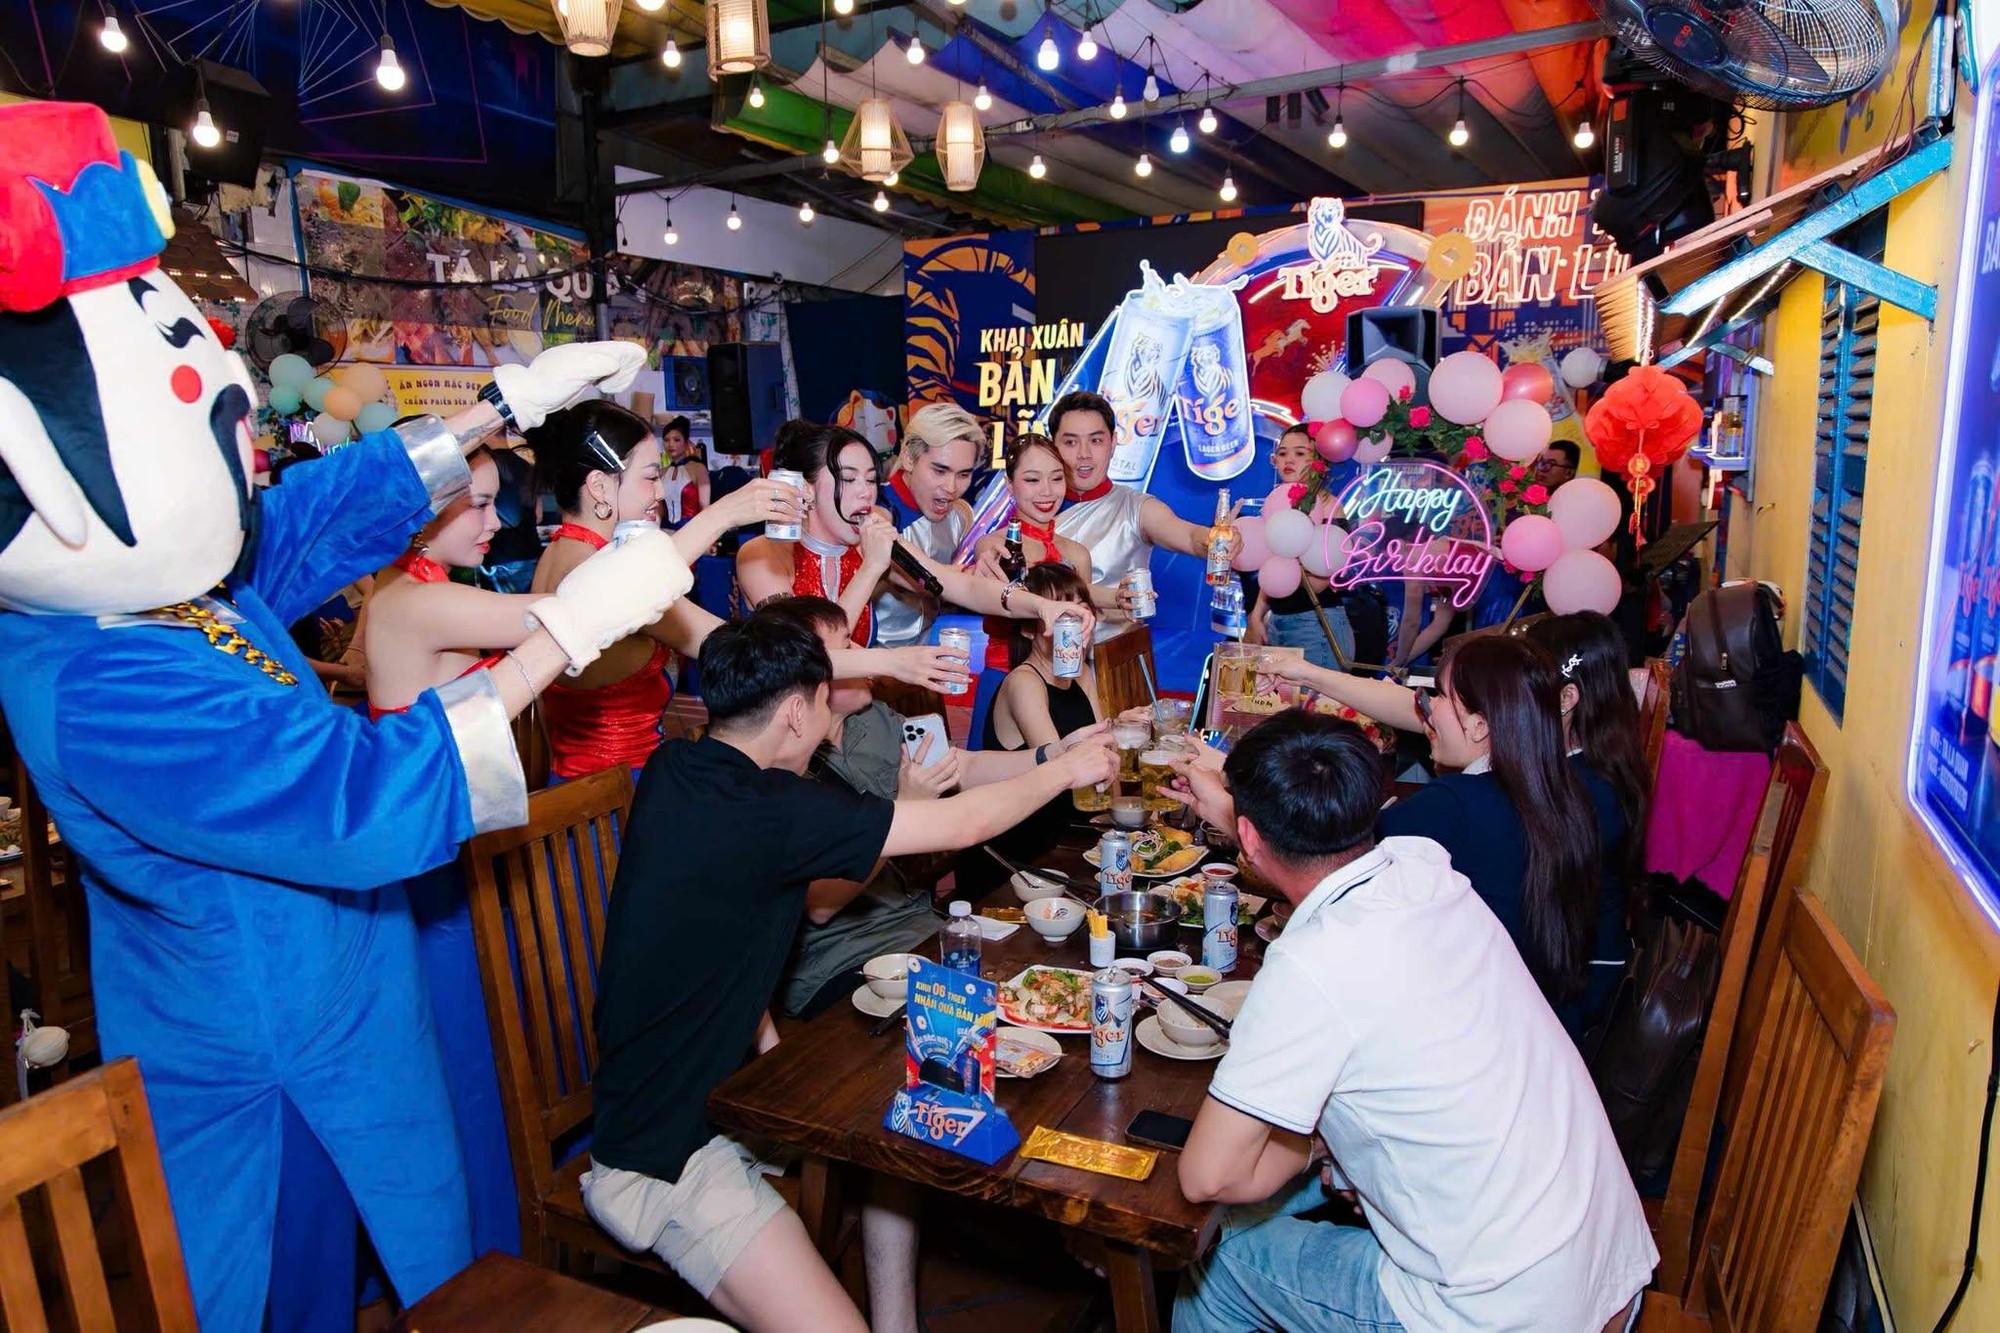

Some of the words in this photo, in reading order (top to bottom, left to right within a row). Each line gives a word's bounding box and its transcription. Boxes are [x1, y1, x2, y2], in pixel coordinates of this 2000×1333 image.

[1278, 259, 1379, 313] Tiger
[1455, 236, 1562, 305] BẢN
[486, 293, 538, 331] Food
[542, 299, 595, 331] Menu
[979, 327, 1026, 354] KHAI
[1030, 318, 1085, 351] XUÂN
[416, 379, 441, 389] NGON
[973, 346, 1057, 408] BẢN
[1356, 467, 1463, 532] Happy
[1329, 521, 1494, 608] Birthday
[932, 982, 946, 998] 06
[947, 991, 967, 1005] TIGER
[914, 1100, 971, 1140] Tiger
